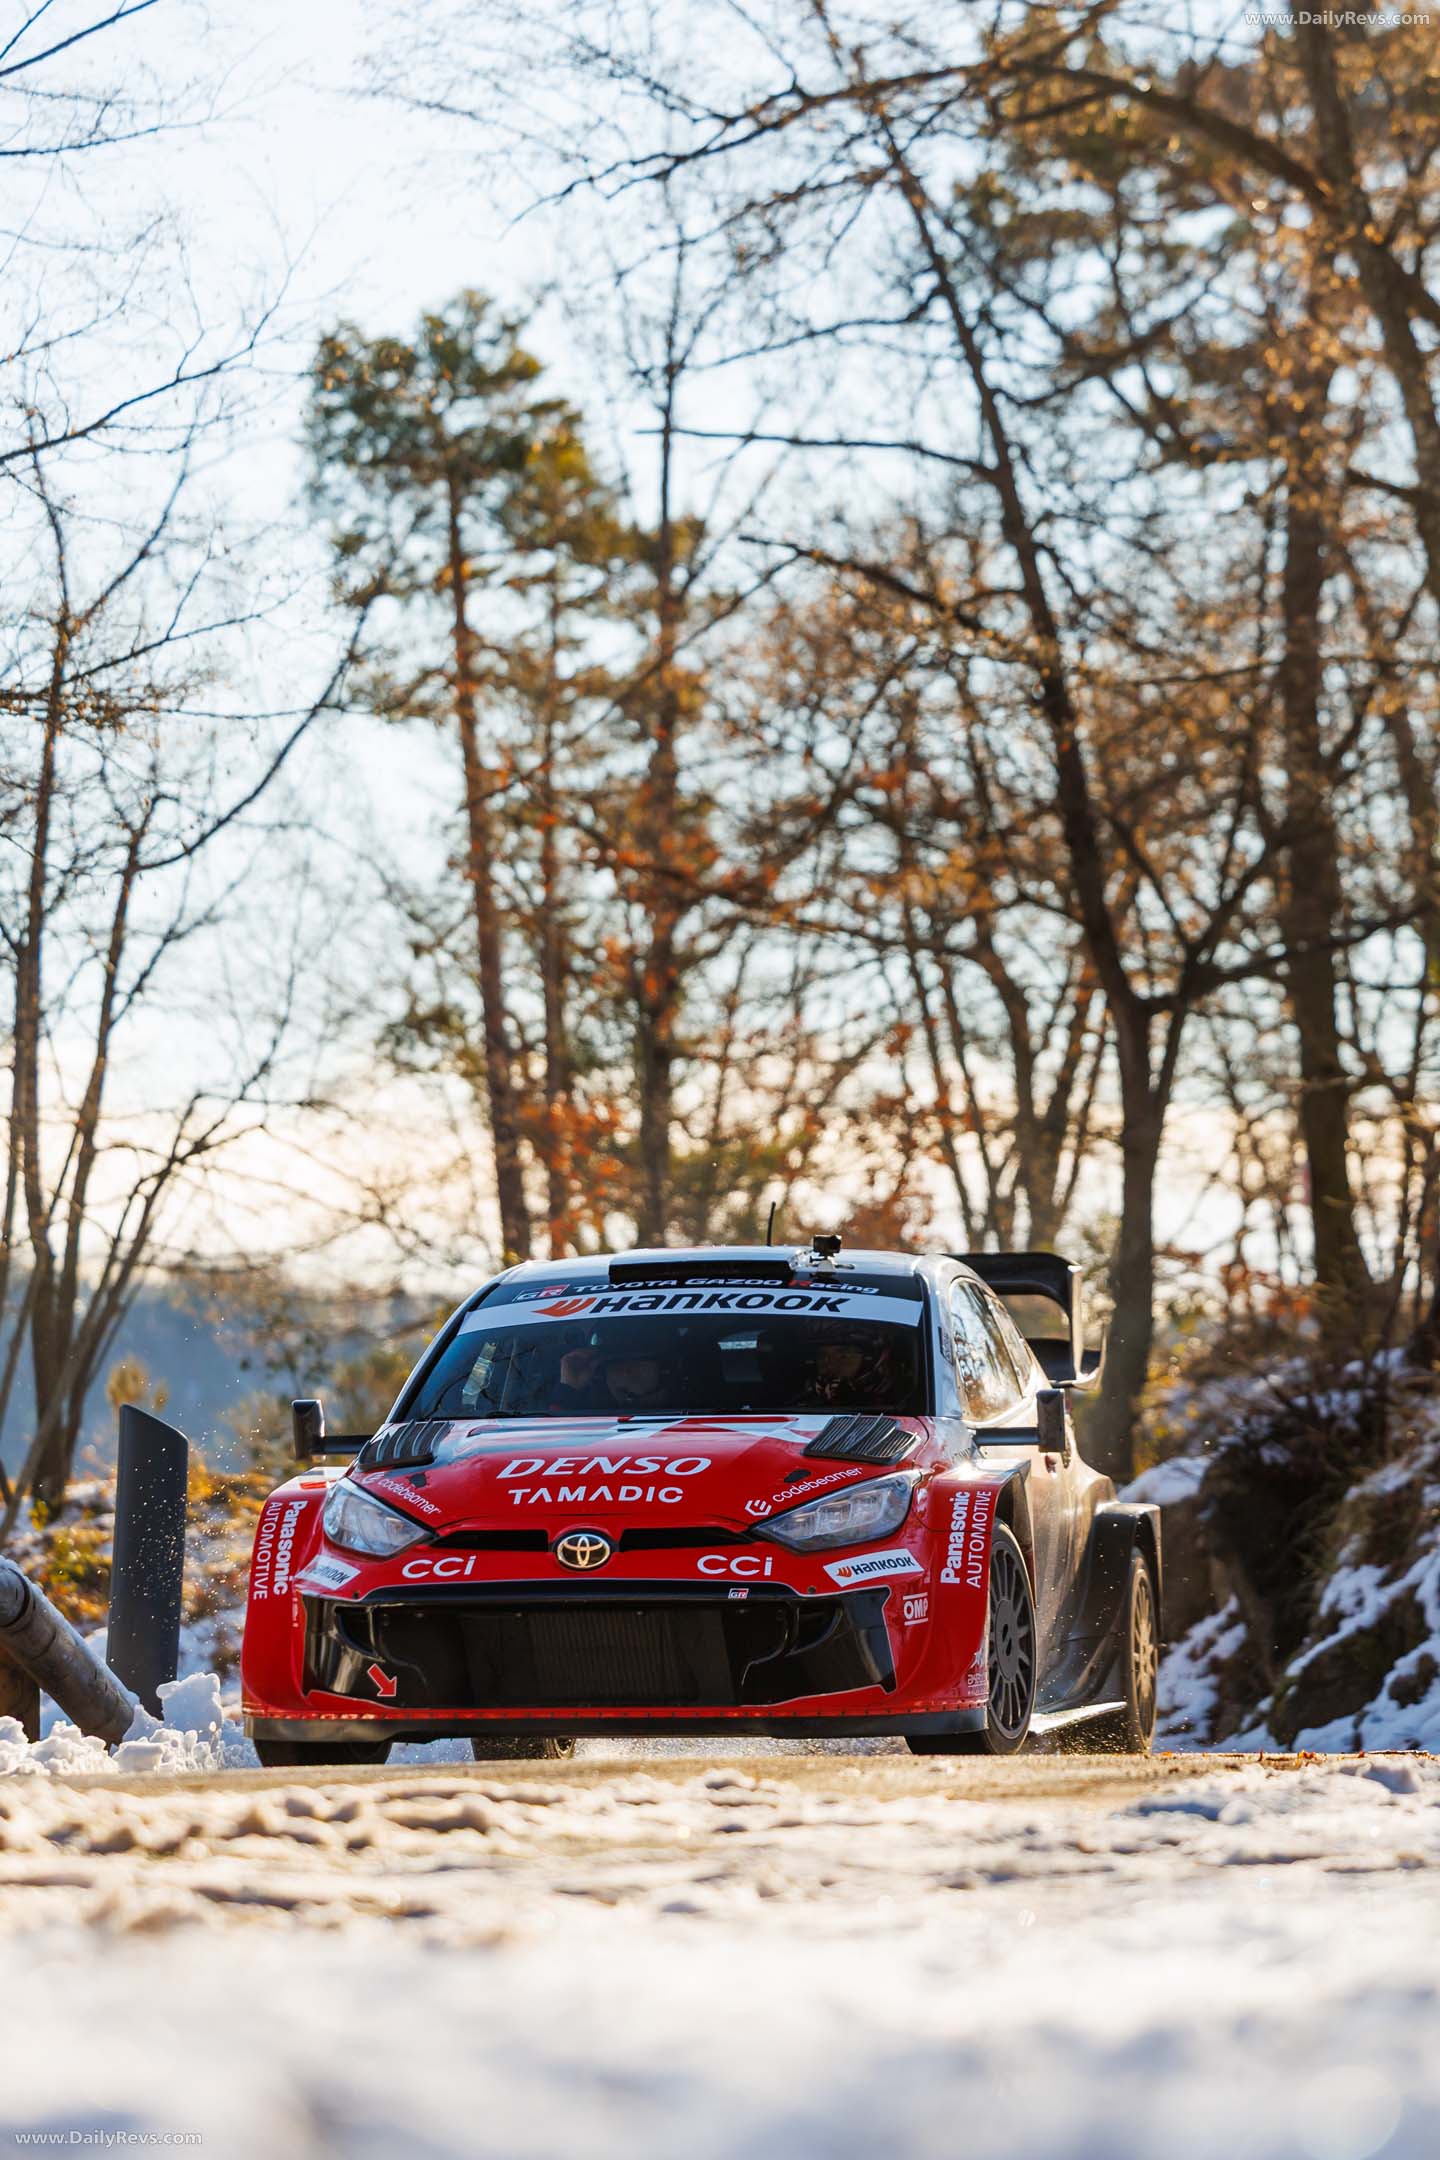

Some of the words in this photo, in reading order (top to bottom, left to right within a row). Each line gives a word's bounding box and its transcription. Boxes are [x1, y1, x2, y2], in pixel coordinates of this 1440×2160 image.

[573, 1279, 677, 1293] TOYOTA
[684, 1278, 783, 1286] GAZOO
[789, 1279, 880, 1295] Racing
[496, 1456, 712, 1480] DENSO
[772, 1467, 863, 1502] codebeamer
[378, 1478, 442, 1515] codebeamer
[508, 1485, 684, 1505] TAMADIC
[253, 1502, 283, 1600] AUTOMOTIVE
[273, 1500, 308, 1596] Panasonic
[940, 1491, 971, 1584] Panasonic
[966, 1490, 992, 1588] AUTOMOTIVE
[731, 1591, 747, 1599] GR
[903, 1598, 929, 1620] OMP
